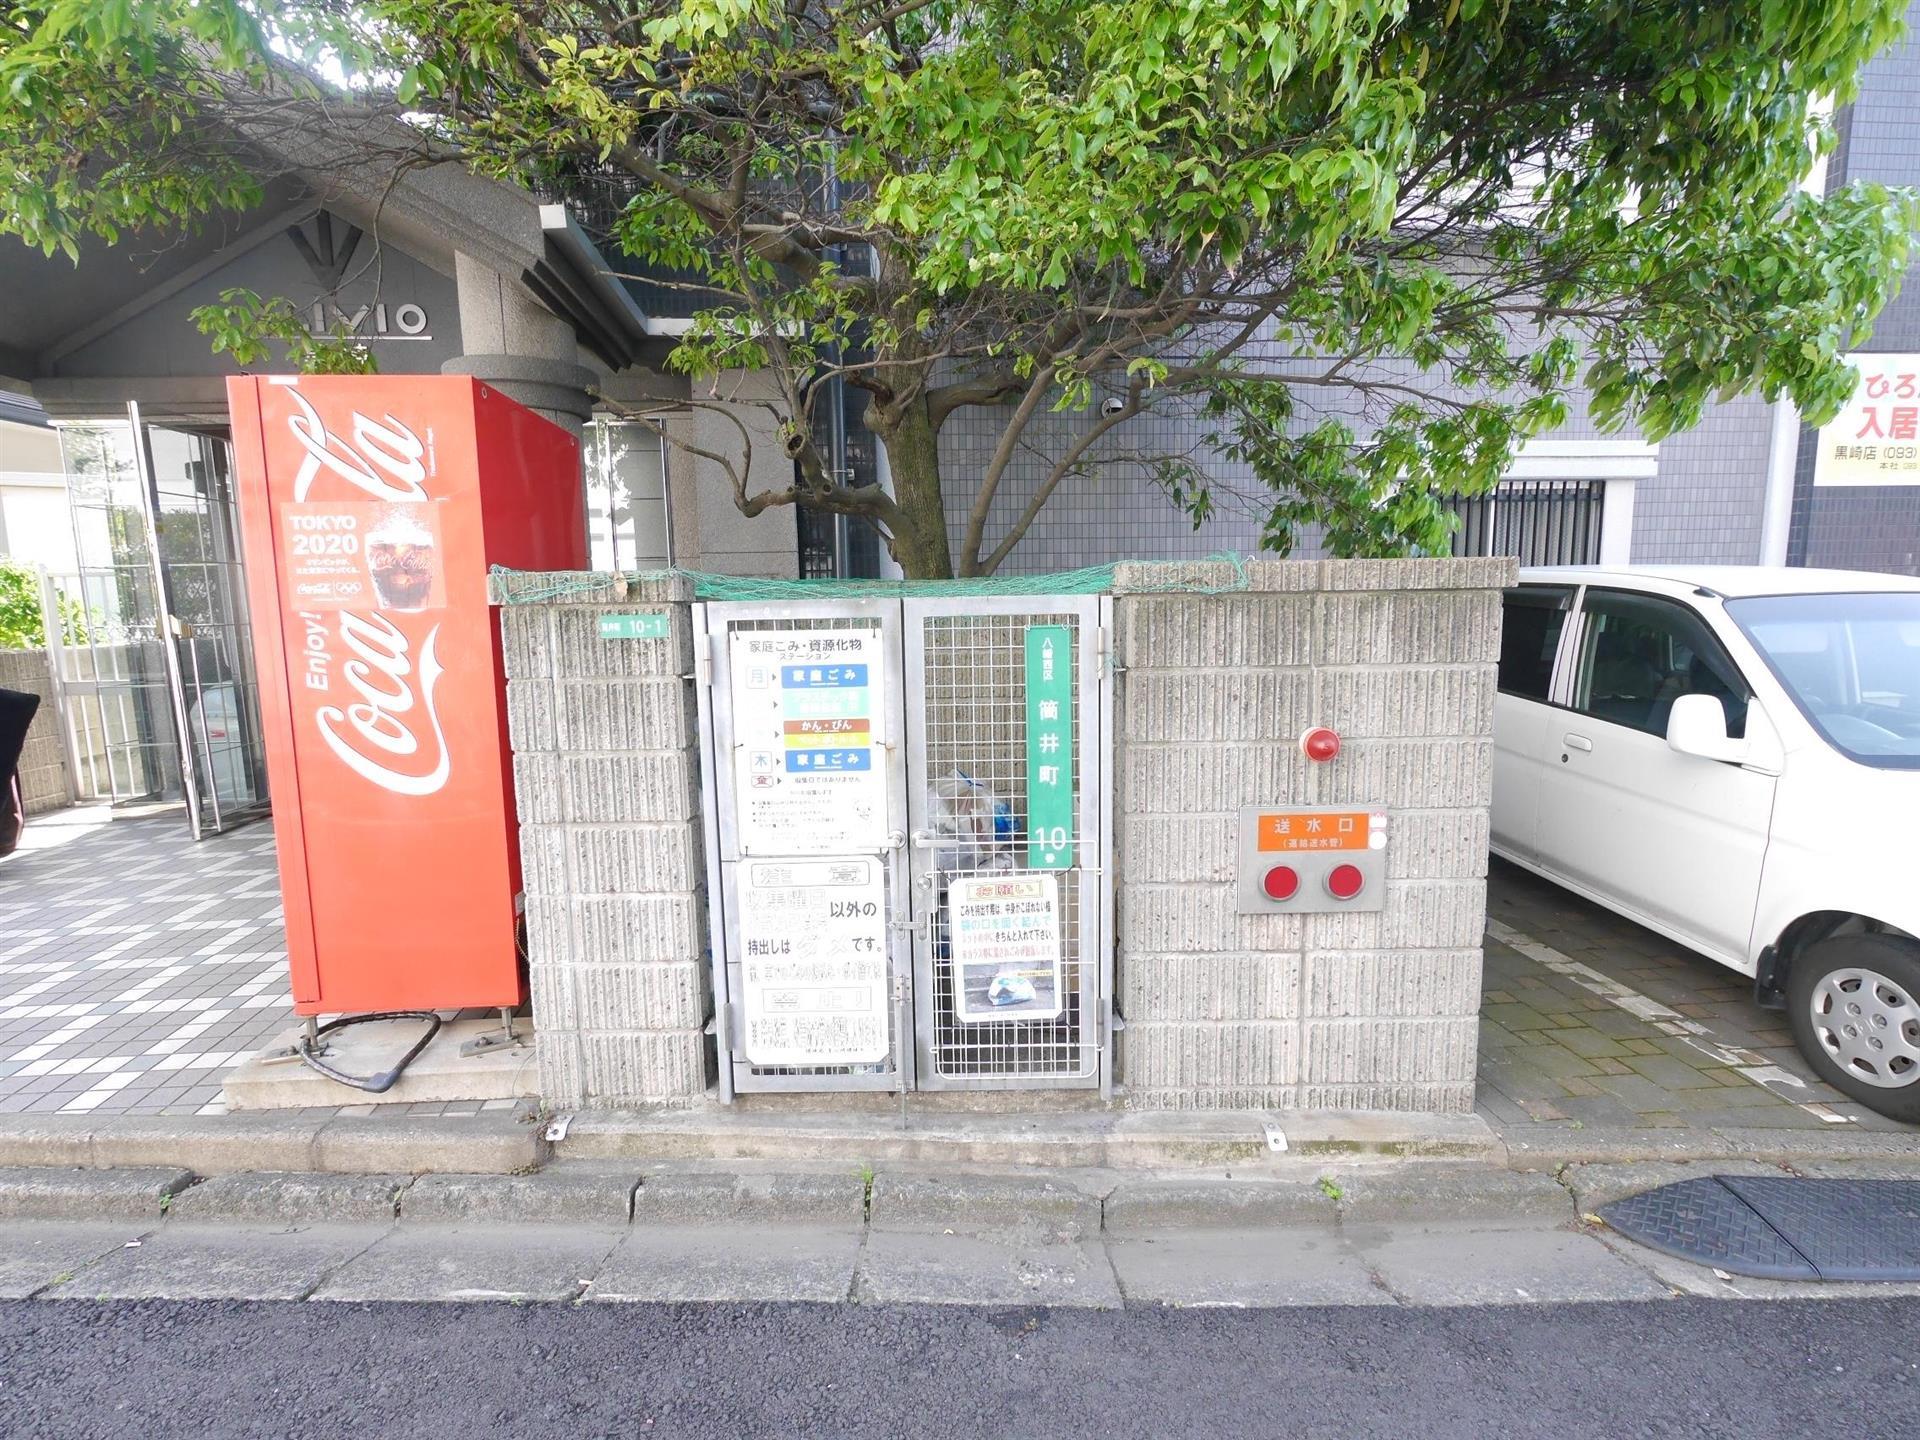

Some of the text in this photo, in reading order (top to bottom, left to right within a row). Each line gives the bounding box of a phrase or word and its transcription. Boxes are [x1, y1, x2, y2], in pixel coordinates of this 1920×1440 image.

[301, 303, 428, 334] IVIO
[1865, 373, 1920, 399] ひろ
[1856, 406, 1919, 440] 入居
[1834, 445, 1877, 460] 黒崎店
[289, 515, 357, 530] TOKYO
[292, 533, 359, 555] 2020
[300, 611, 332, 691] Enjoy!
[1274, 818, 1353, 834] 送水口
[1034, 826, 1067, 852] 10
[829, 901, 877, 918] 以外の
